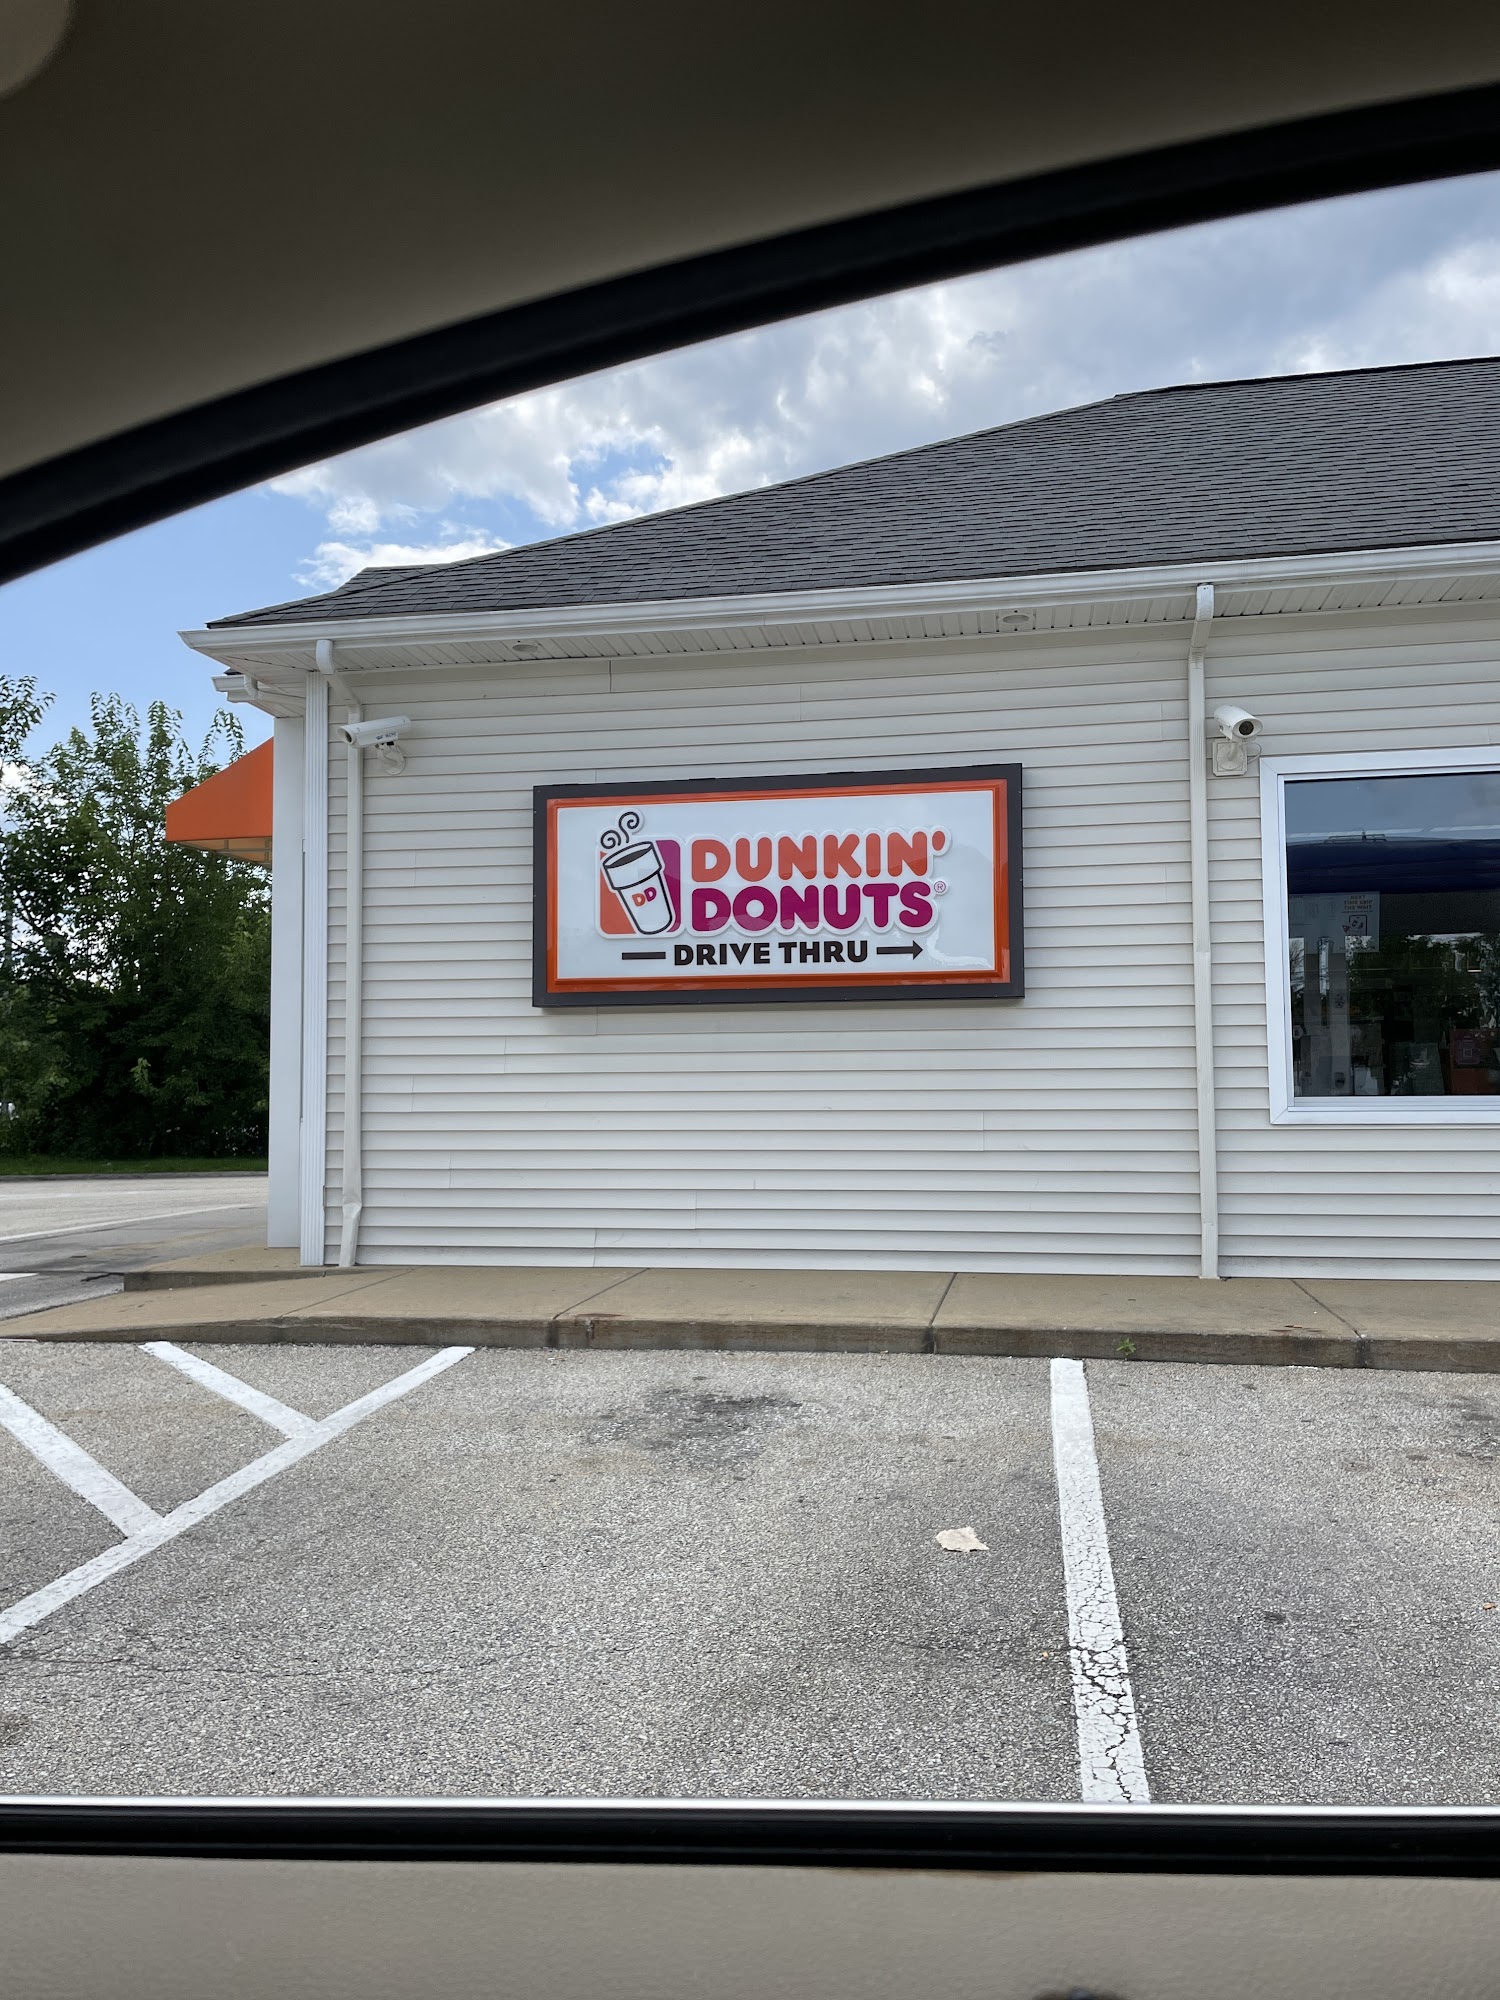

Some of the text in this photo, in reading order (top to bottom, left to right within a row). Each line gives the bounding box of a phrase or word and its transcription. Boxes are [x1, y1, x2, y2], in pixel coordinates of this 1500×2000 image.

[691, 830, 946, 883] DUNKIN'
[632, 886, 657, 907] DD
[674, 940, 869, 966] DRIVE THRU
